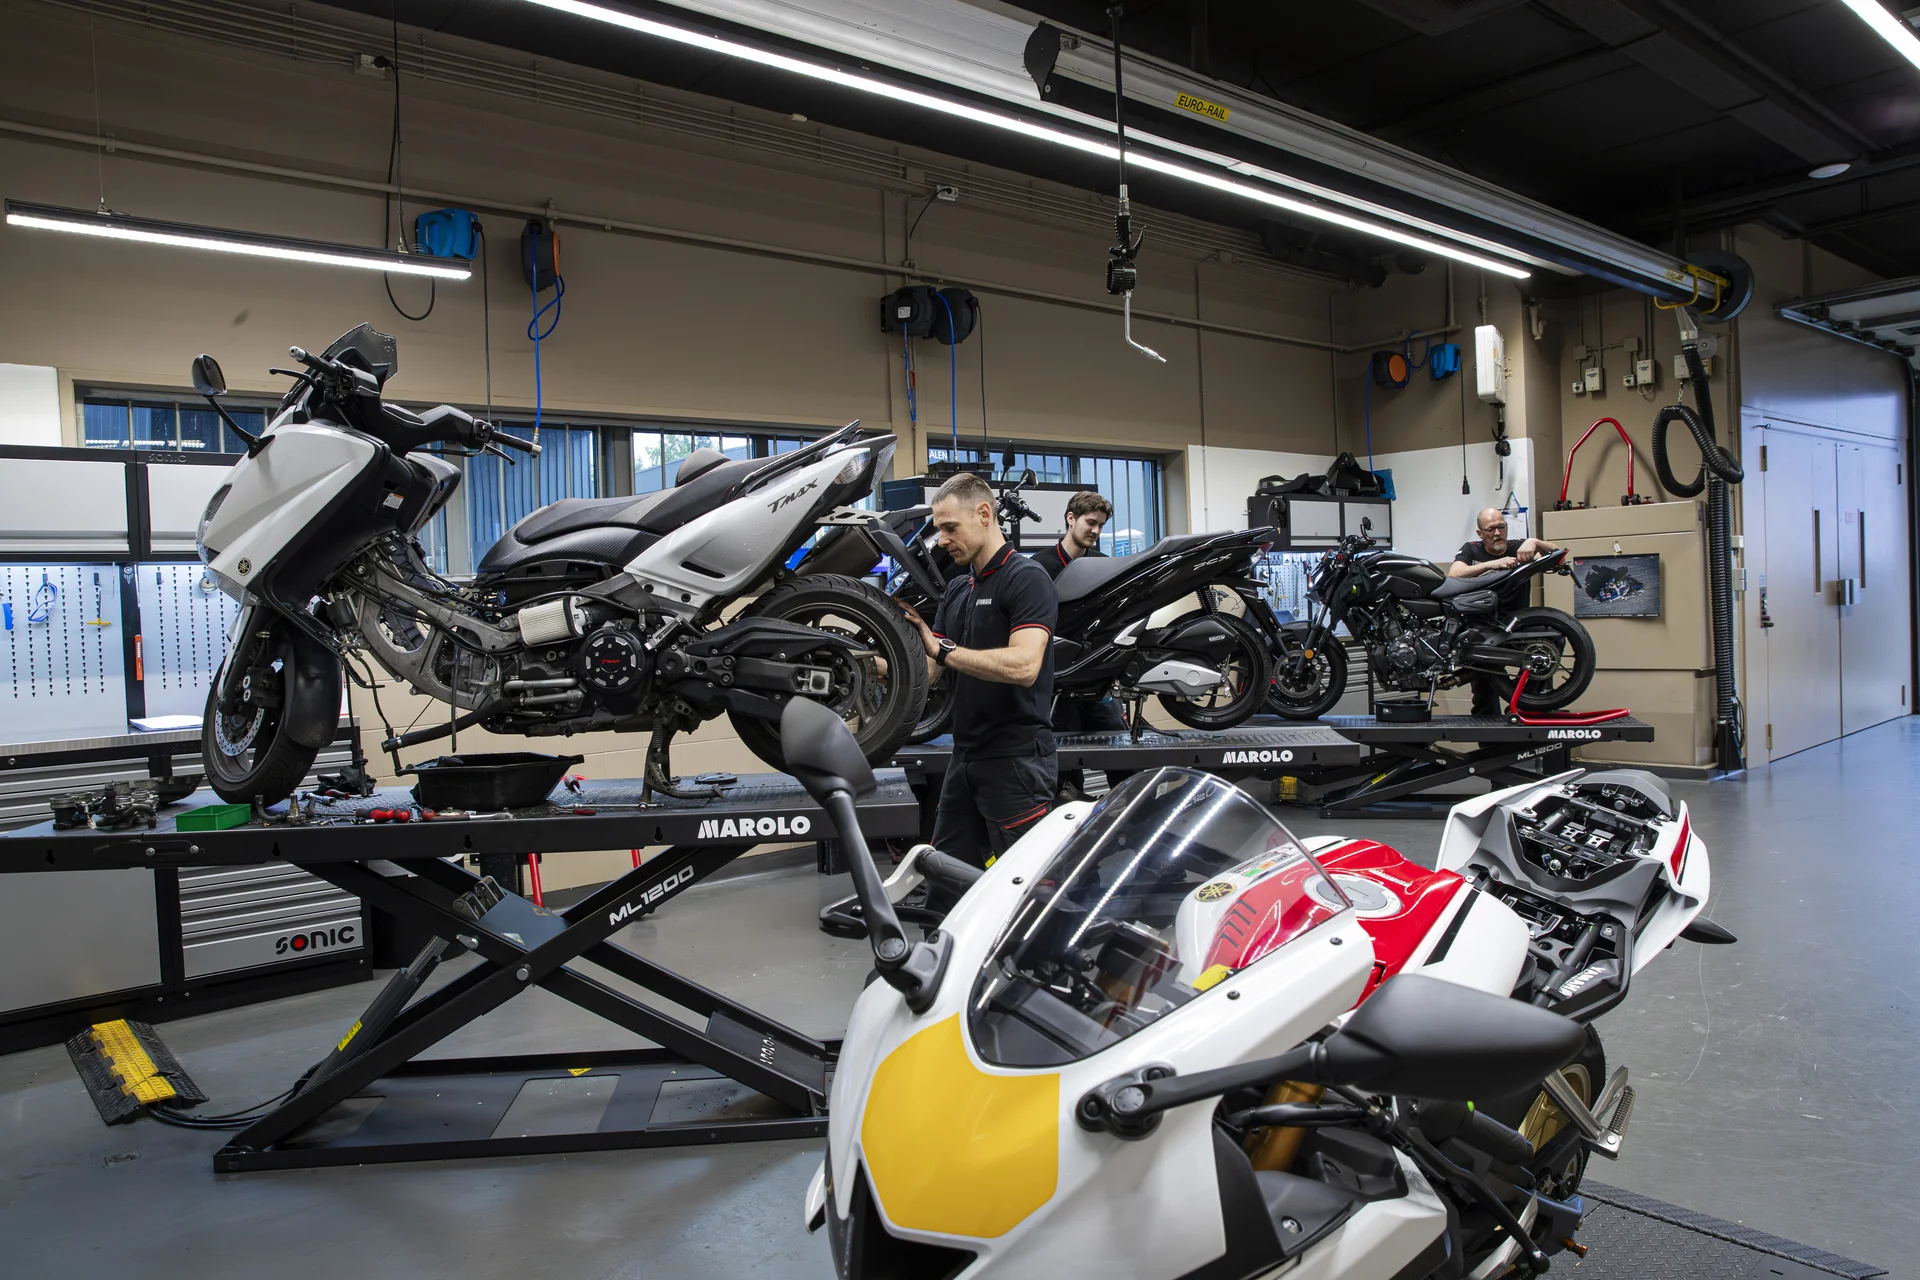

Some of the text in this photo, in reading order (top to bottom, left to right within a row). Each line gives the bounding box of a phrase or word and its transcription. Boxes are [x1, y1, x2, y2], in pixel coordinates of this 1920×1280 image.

[1178, 95, 1225, 120] EURO-RAIL
[767, 477, 819, 514] TMAX
[1547, 729, 1602, 739] MAROLO
[1222, 750, 1294, 764] MAROLO
[1517, 742, 1563, 760] ML1200
[697, 816, 811, 839] MAROLO
[608, 864, 695, 926] ML1200
[275, 926, 355, 955] SONIC
[1558, 966, 1606, 999] YAMAHA
